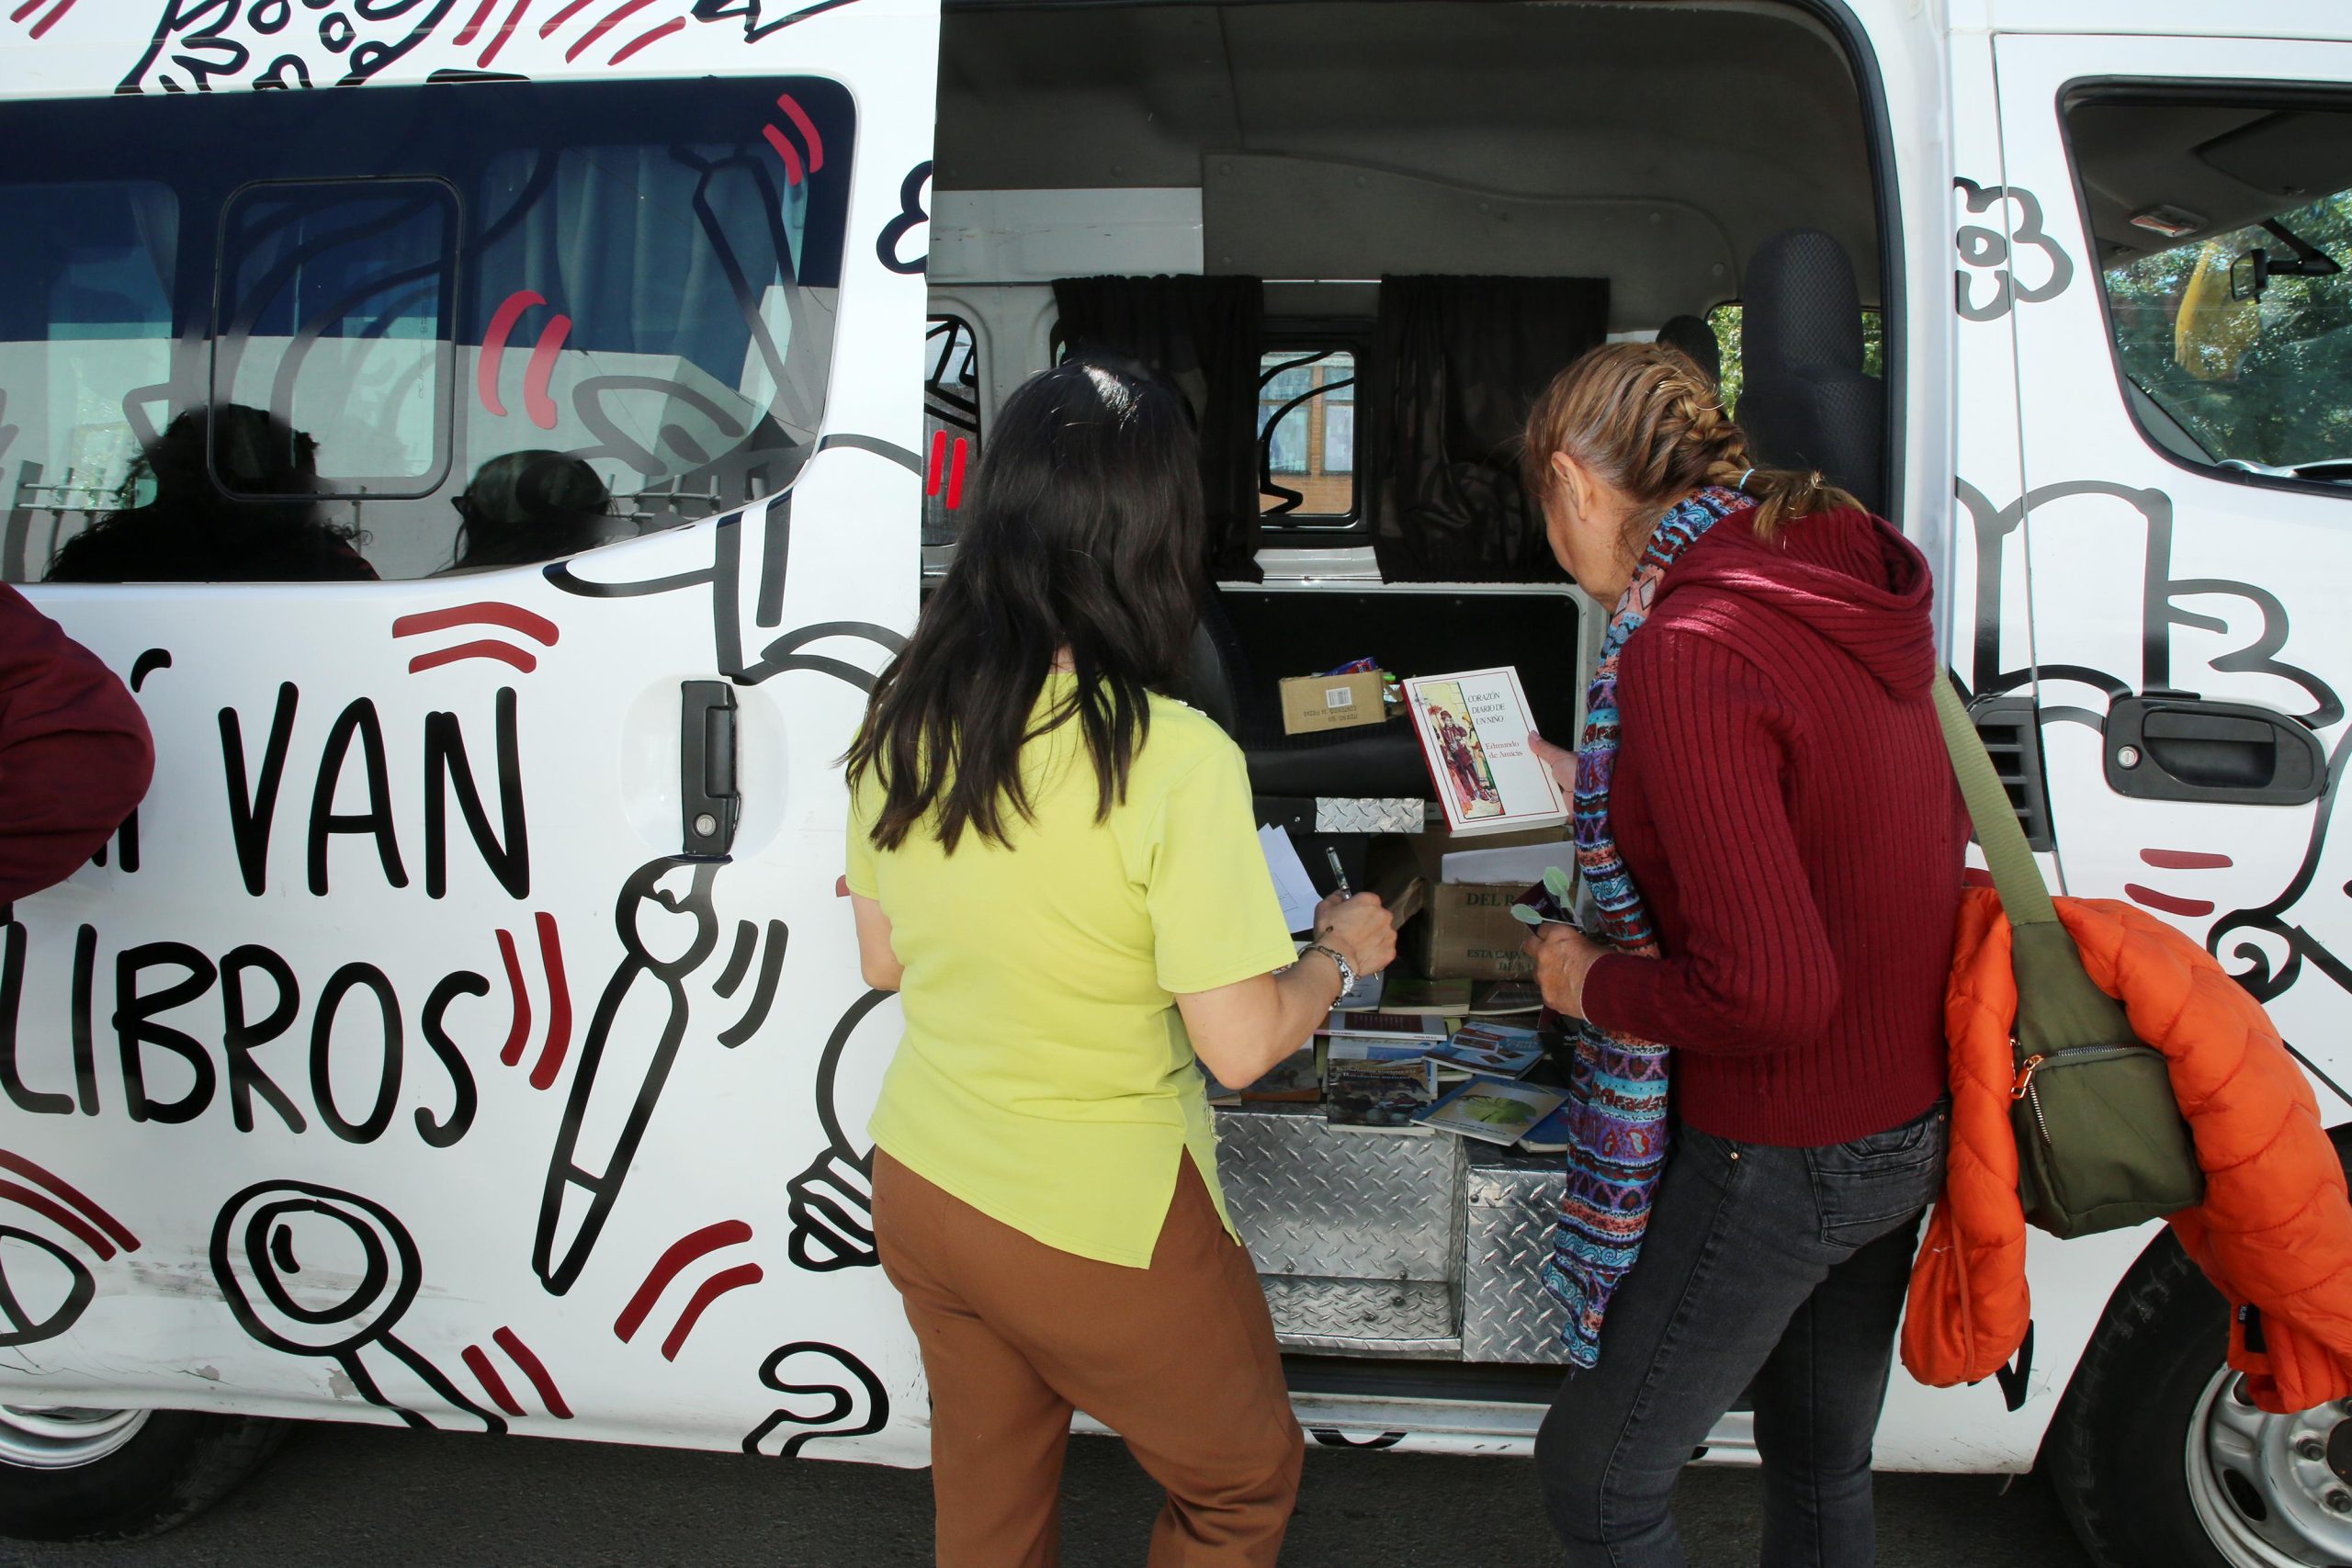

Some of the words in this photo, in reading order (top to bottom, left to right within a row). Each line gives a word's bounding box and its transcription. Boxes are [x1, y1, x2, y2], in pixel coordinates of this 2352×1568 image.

[1467, 692, 1499, 702] CORAZÓN
[1472, 705, 1495, 714] DIARIO
[1487, 715, 1504, 723] NIÑO
[1485, 740, 1519, 750] Edmundo
[218, 681, 530, 899] VAN
[1466, 894, 1501, 906] DEL
[1467, 949, 1493, 959] ESTA
[0, 919, 490, 1148] LIBROS
